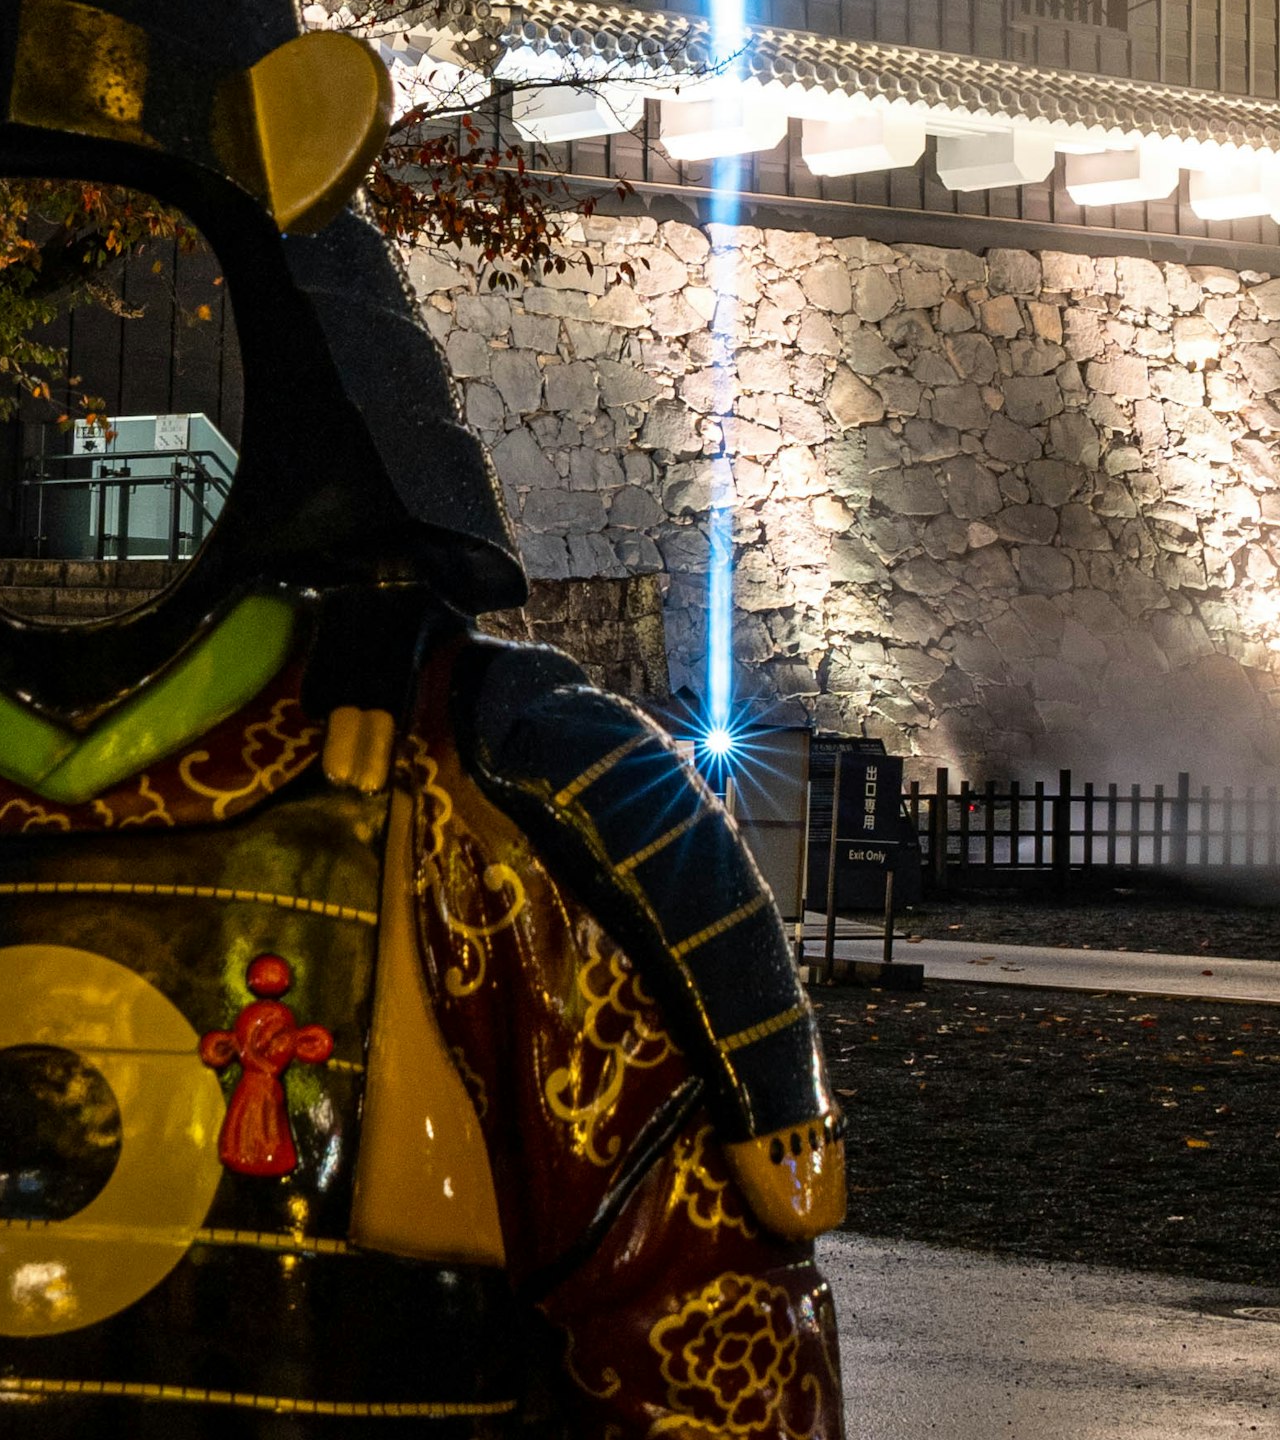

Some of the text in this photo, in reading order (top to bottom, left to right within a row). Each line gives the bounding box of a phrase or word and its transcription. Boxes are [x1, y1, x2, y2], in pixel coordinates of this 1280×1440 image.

[863, 764, 878, 831] 出口専用
[848, 849, 886, 864] Exit Only
